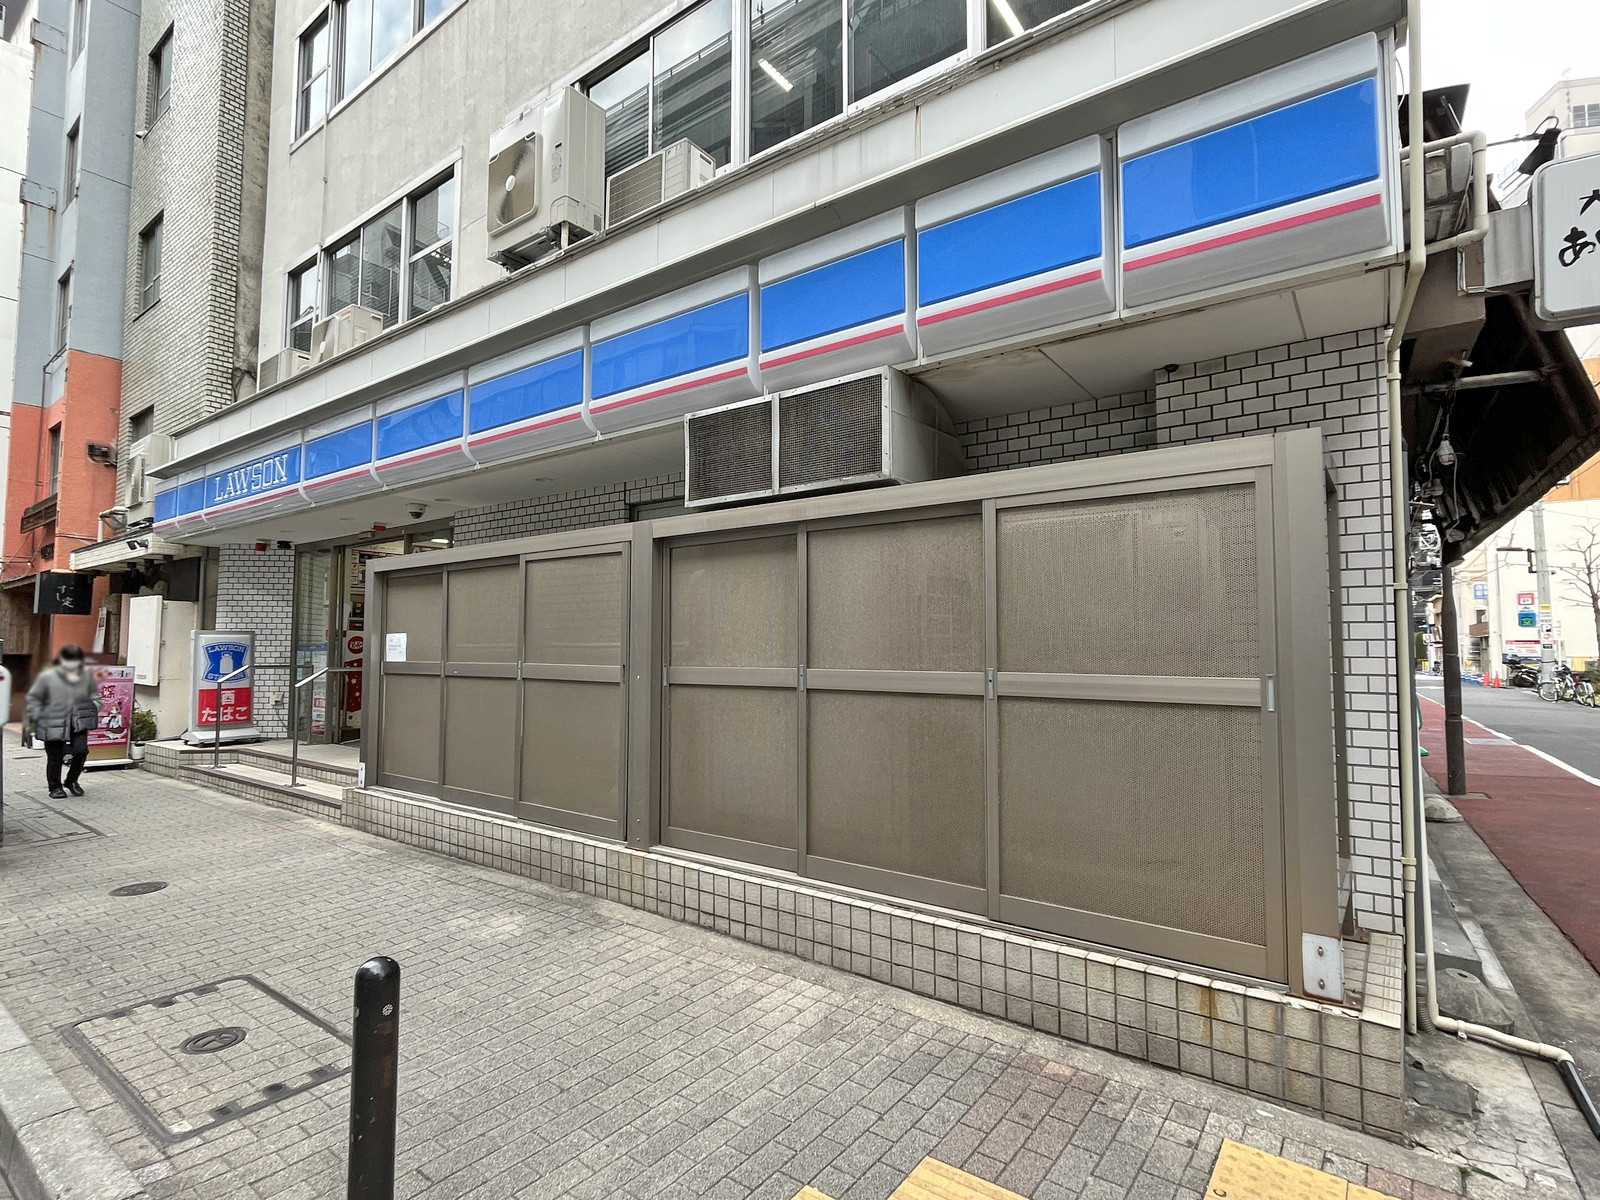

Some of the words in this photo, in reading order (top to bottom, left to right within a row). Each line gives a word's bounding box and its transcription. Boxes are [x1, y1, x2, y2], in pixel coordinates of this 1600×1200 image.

[213, 453, 288, 502] LAWSON
[207, 644, 246, 653] LAWSON
[202, 706, 248, 722] たばこ
